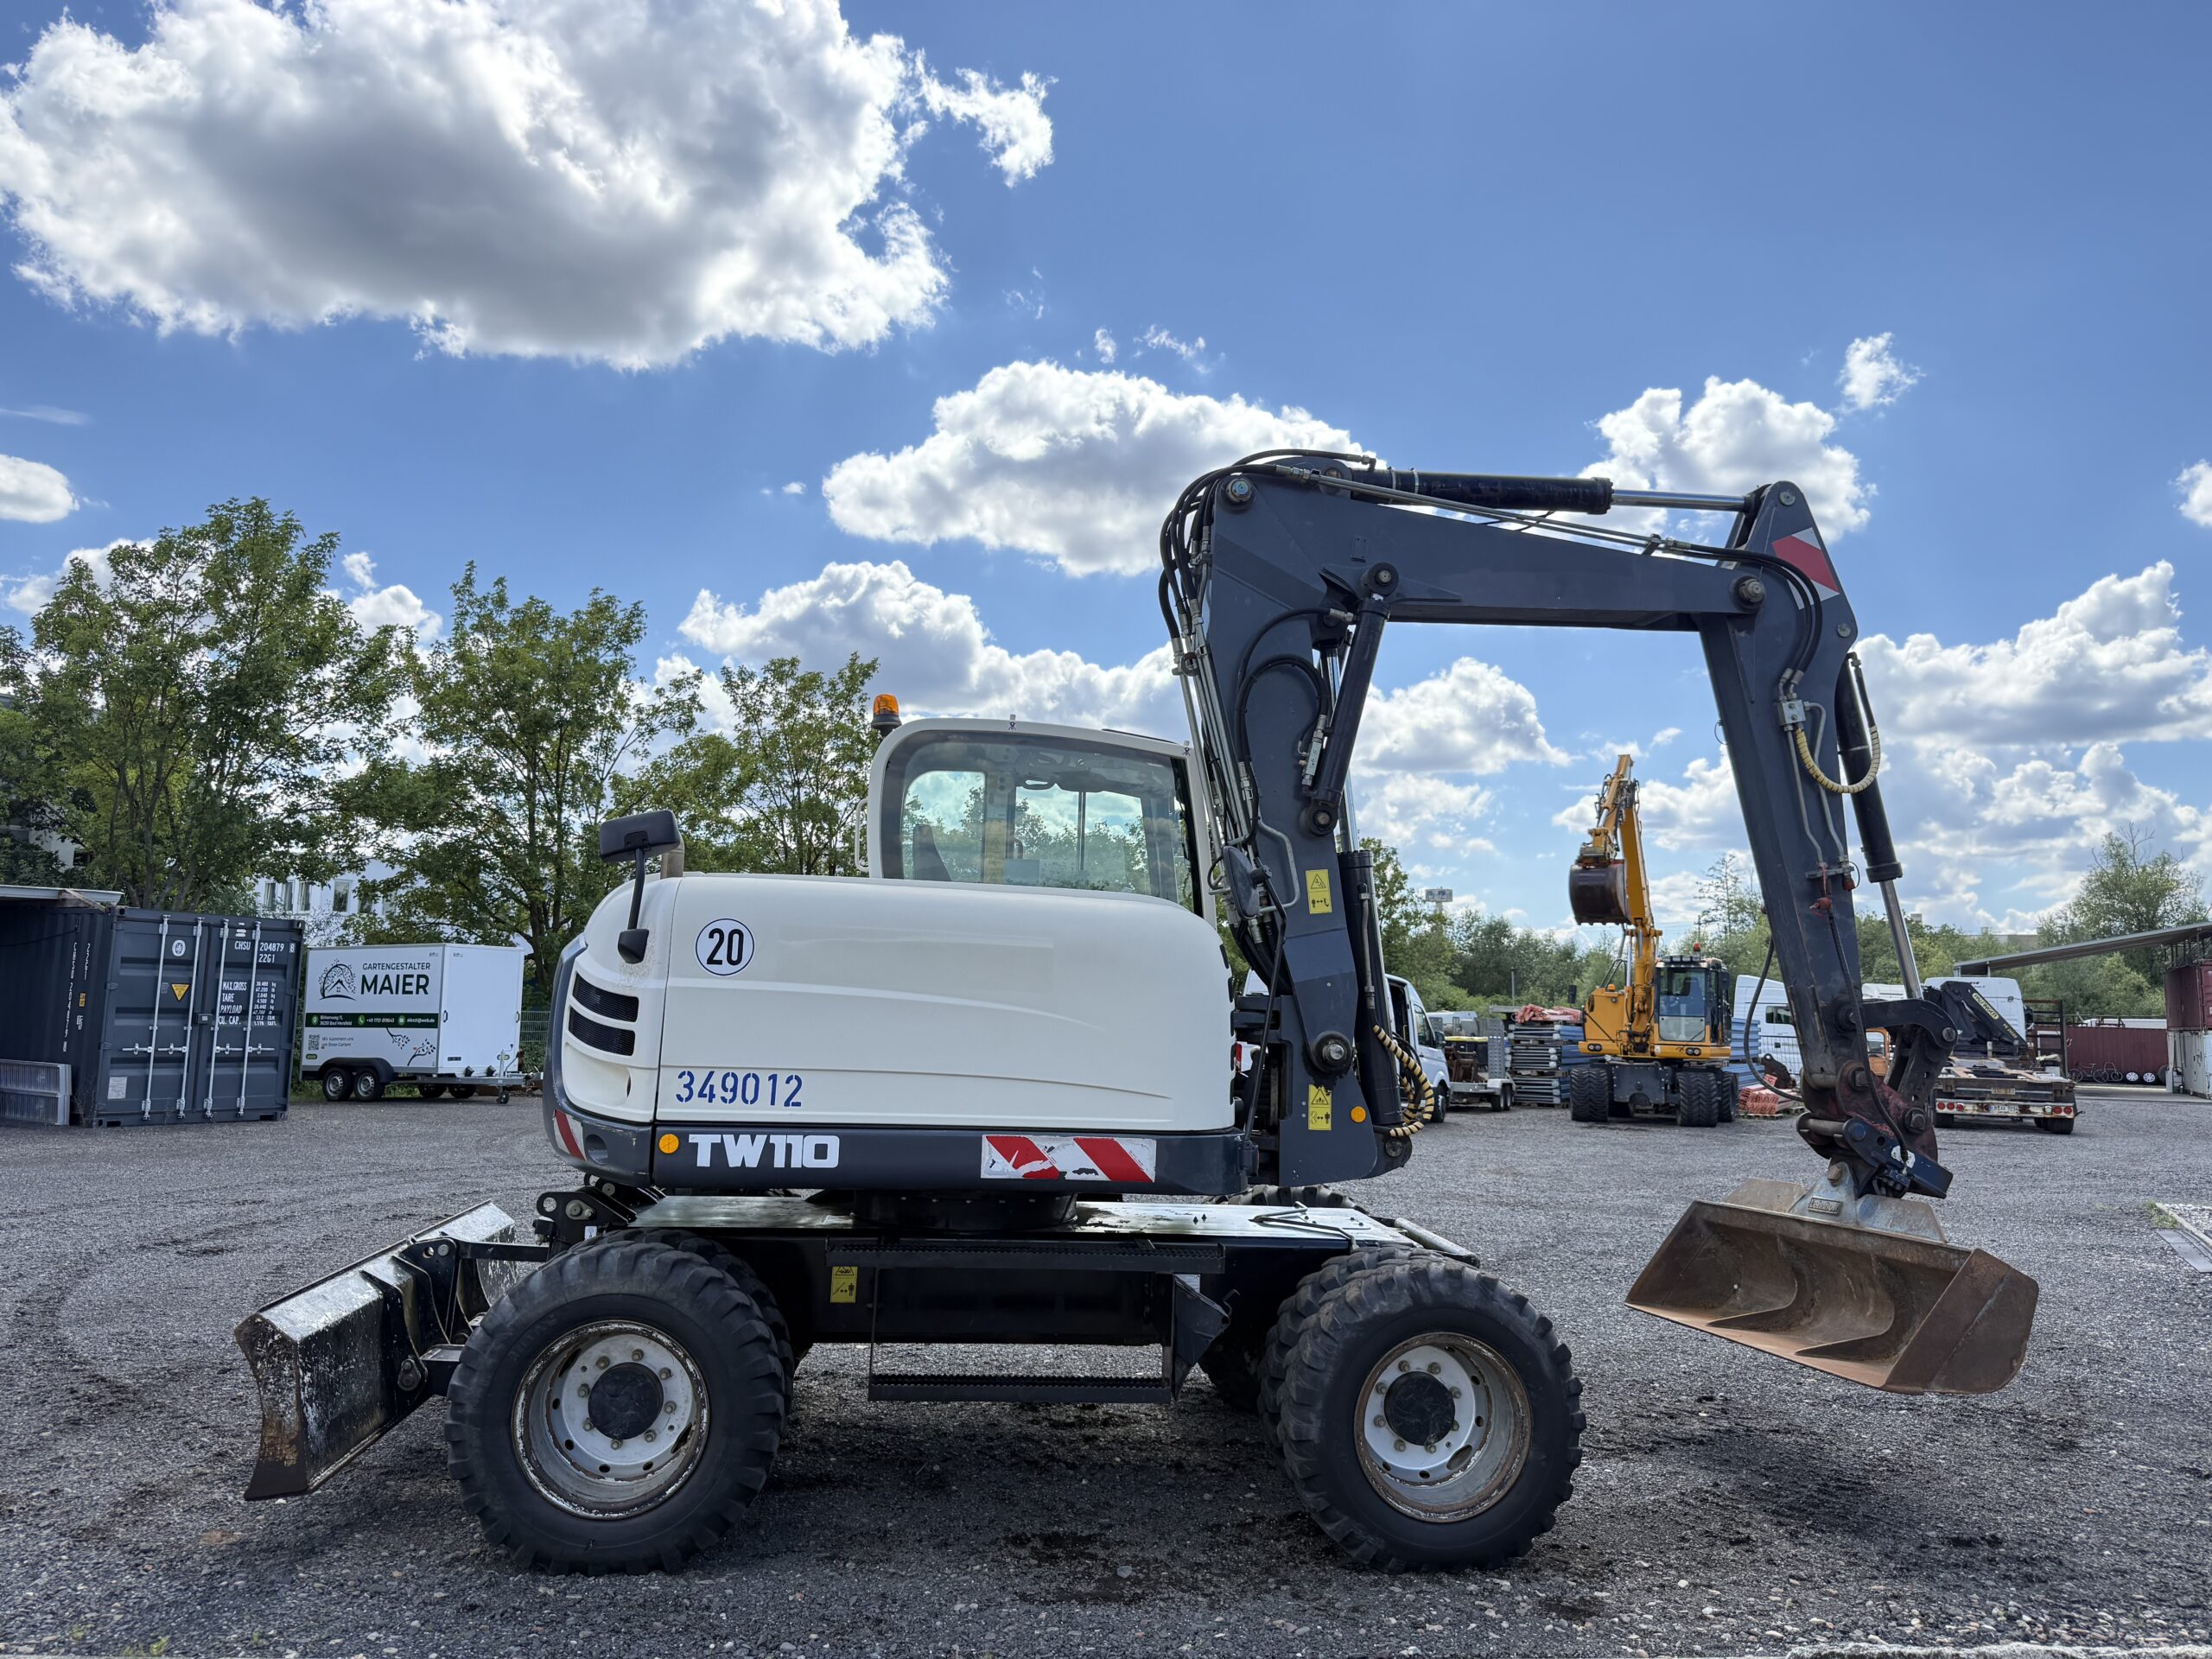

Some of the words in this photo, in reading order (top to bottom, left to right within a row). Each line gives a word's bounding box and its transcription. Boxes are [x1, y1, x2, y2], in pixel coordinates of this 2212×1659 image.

[234, 941, 251, 950] CHSU
[259, 942, 284, 952] 204879
[289, 943, 295, 953] 8
[706, 927, 744, 966] 20
[258, 954, 275, 963] 22G1
[360, 974, 429, 995] MAIER
[222, 993, 235, 1002] TARE
[219, 1004, 243, 1014] PAYLOAD
[228, 1016, 242, 1026] CAP.
[676, 1071, 803, 1107] 349012
[688, 1134, 840, 1168] TW110
